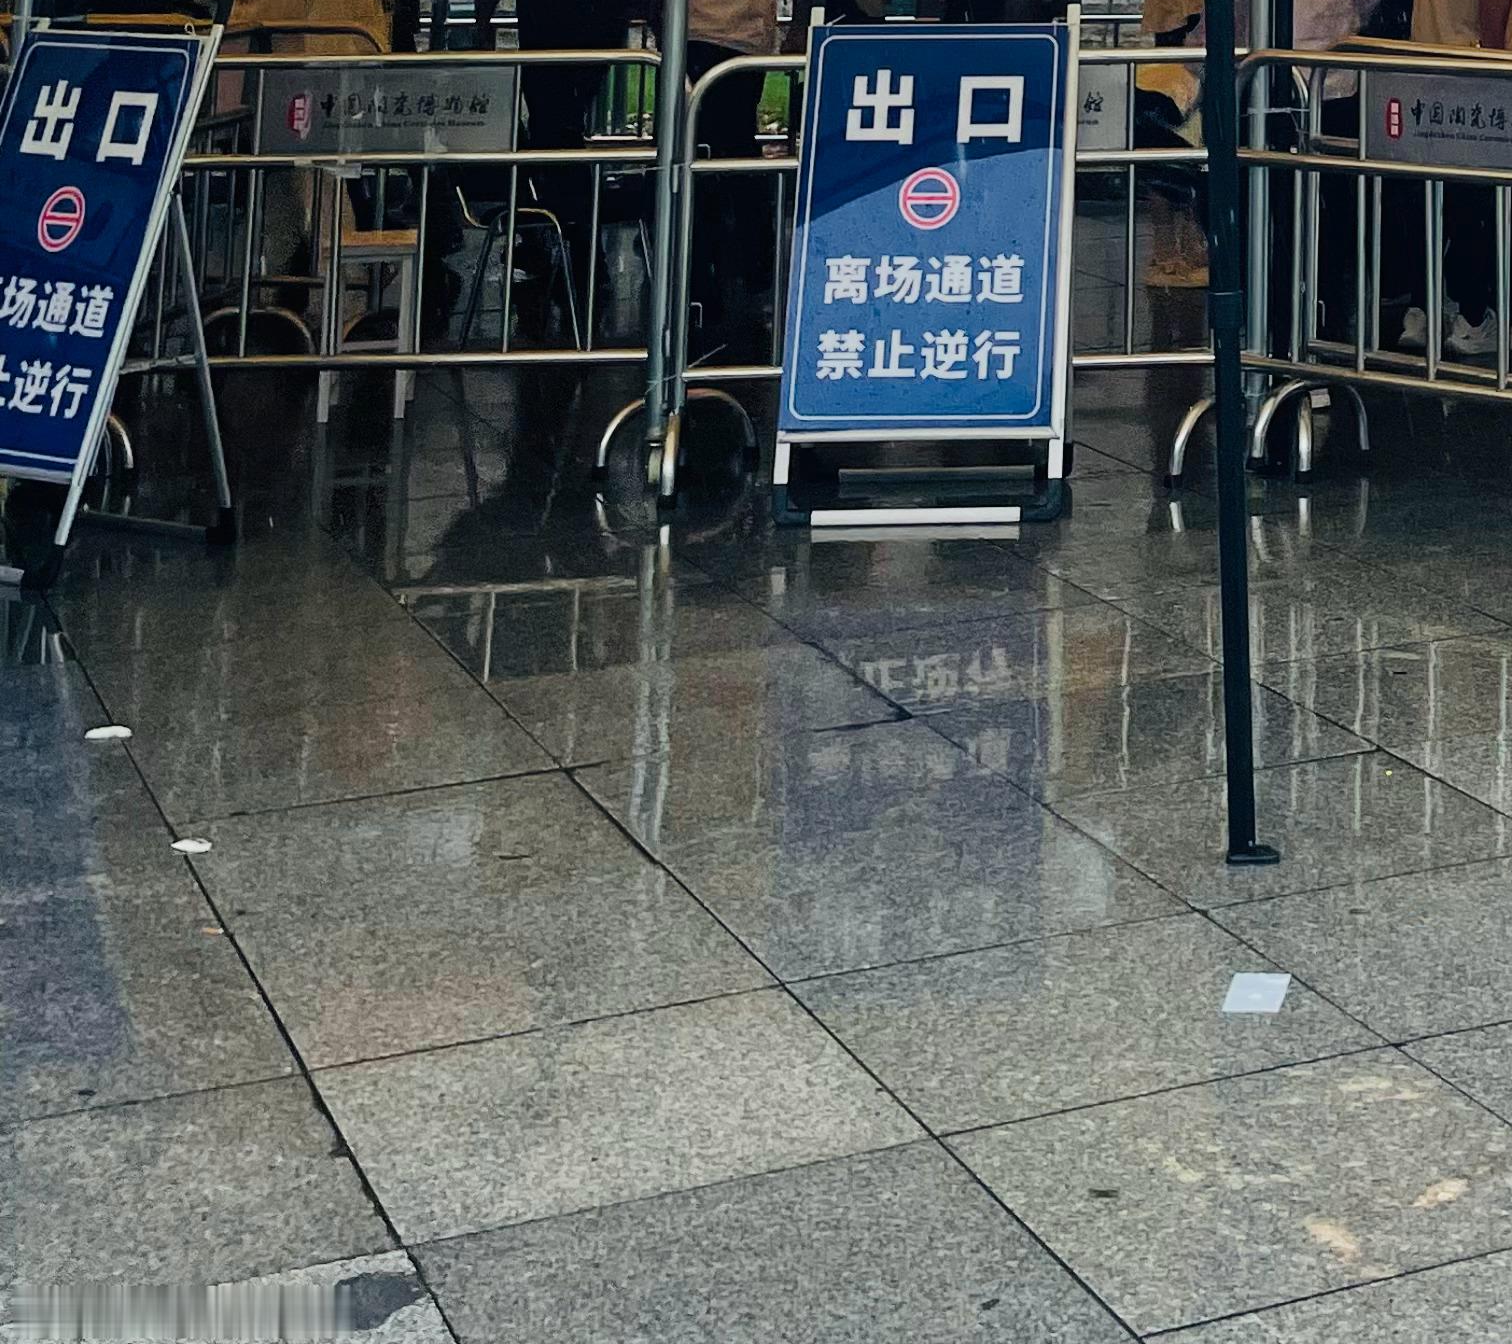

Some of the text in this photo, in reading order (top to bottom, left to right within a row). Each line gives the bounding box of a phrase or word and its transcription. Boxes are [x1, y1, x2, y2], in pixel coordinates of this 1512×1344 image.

[20, 79, 159, 166] 出口
[846, 69, 1025, 145] 出口
[0, 275, 114, 338] 场通道
[823, 255, 1026, 305] 离场通道
[816, 329, 1022, 382] 禁止逆行
